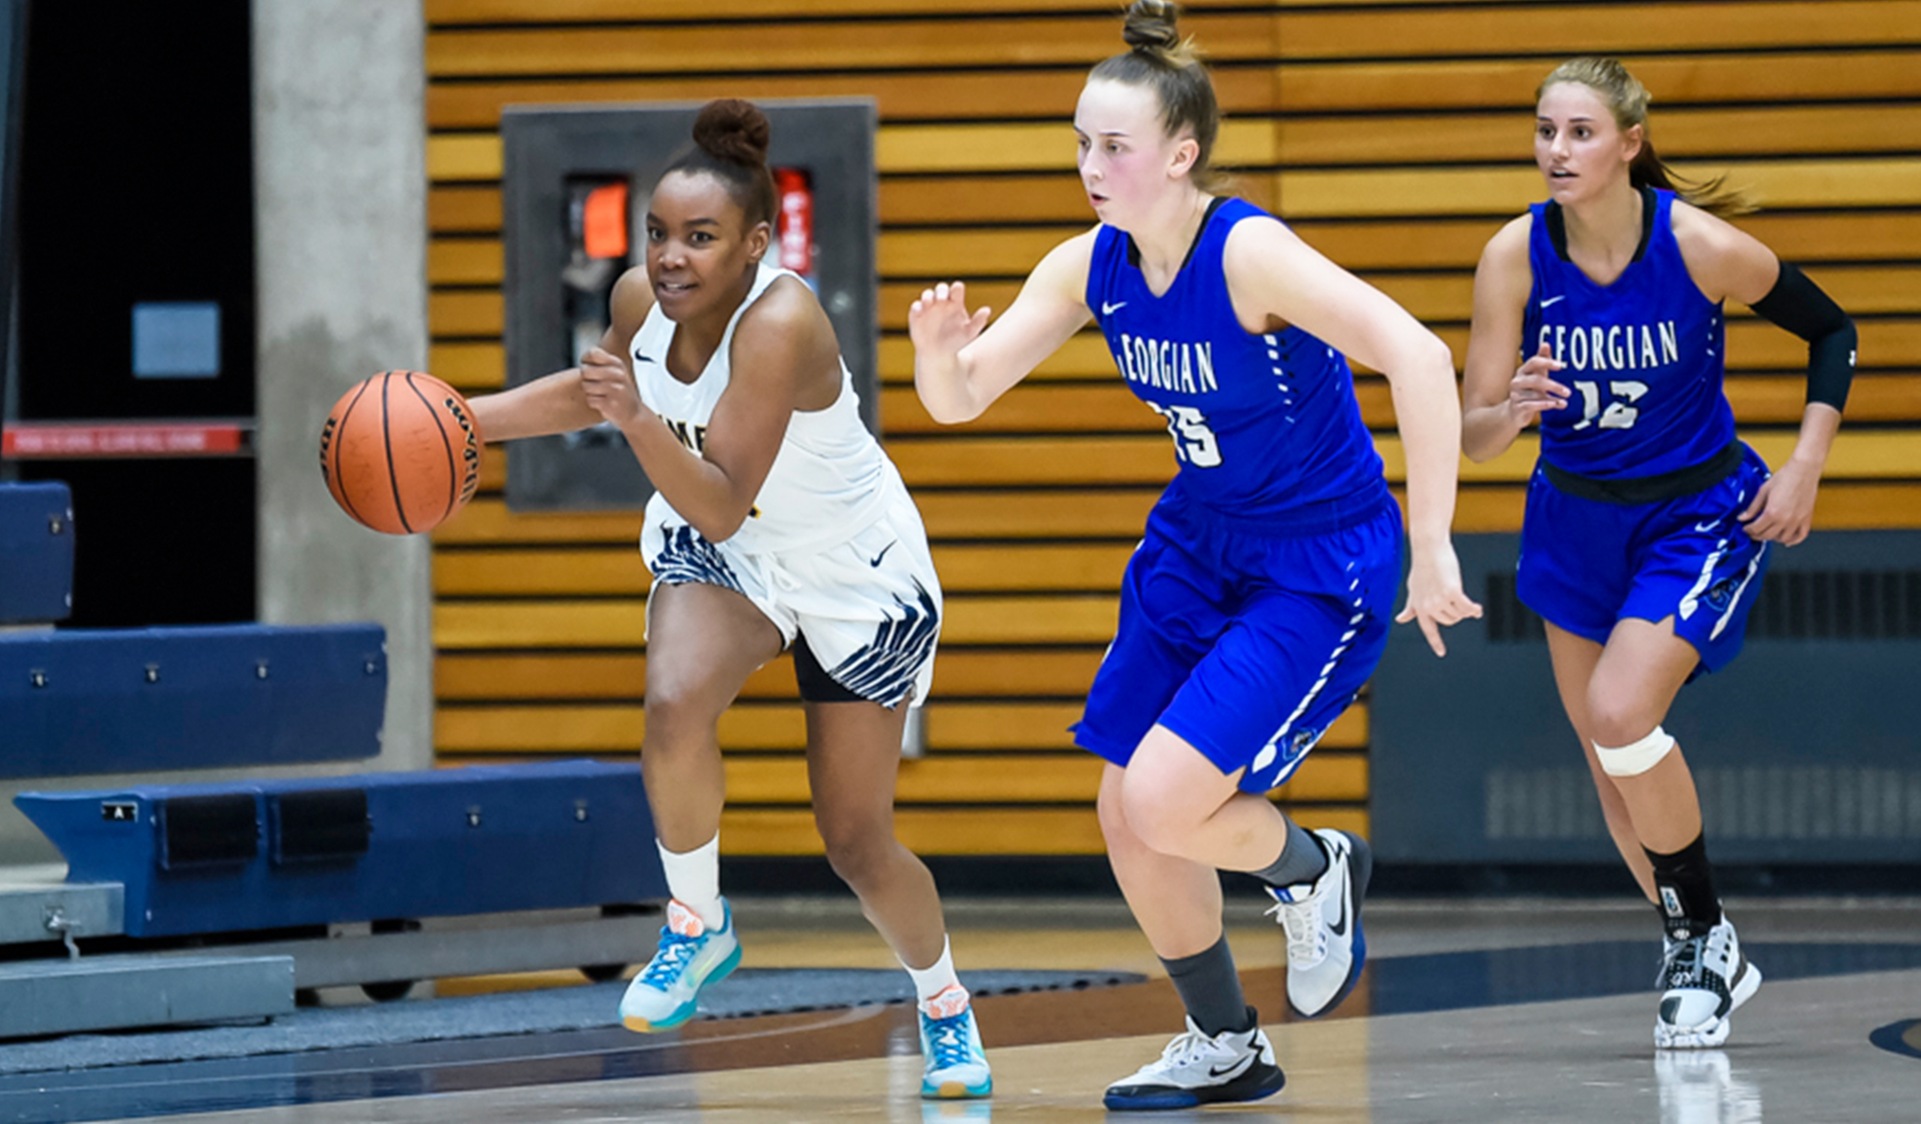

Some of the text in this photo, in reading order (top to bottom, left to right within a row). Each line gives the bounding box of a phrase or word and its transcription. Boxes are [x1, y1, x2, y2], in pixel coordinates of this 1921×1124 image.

[1116, 333, 1218, 394] EORGIAN
[1572, 380, 1649, 431] 12
[114, 805, 125, 819] A
